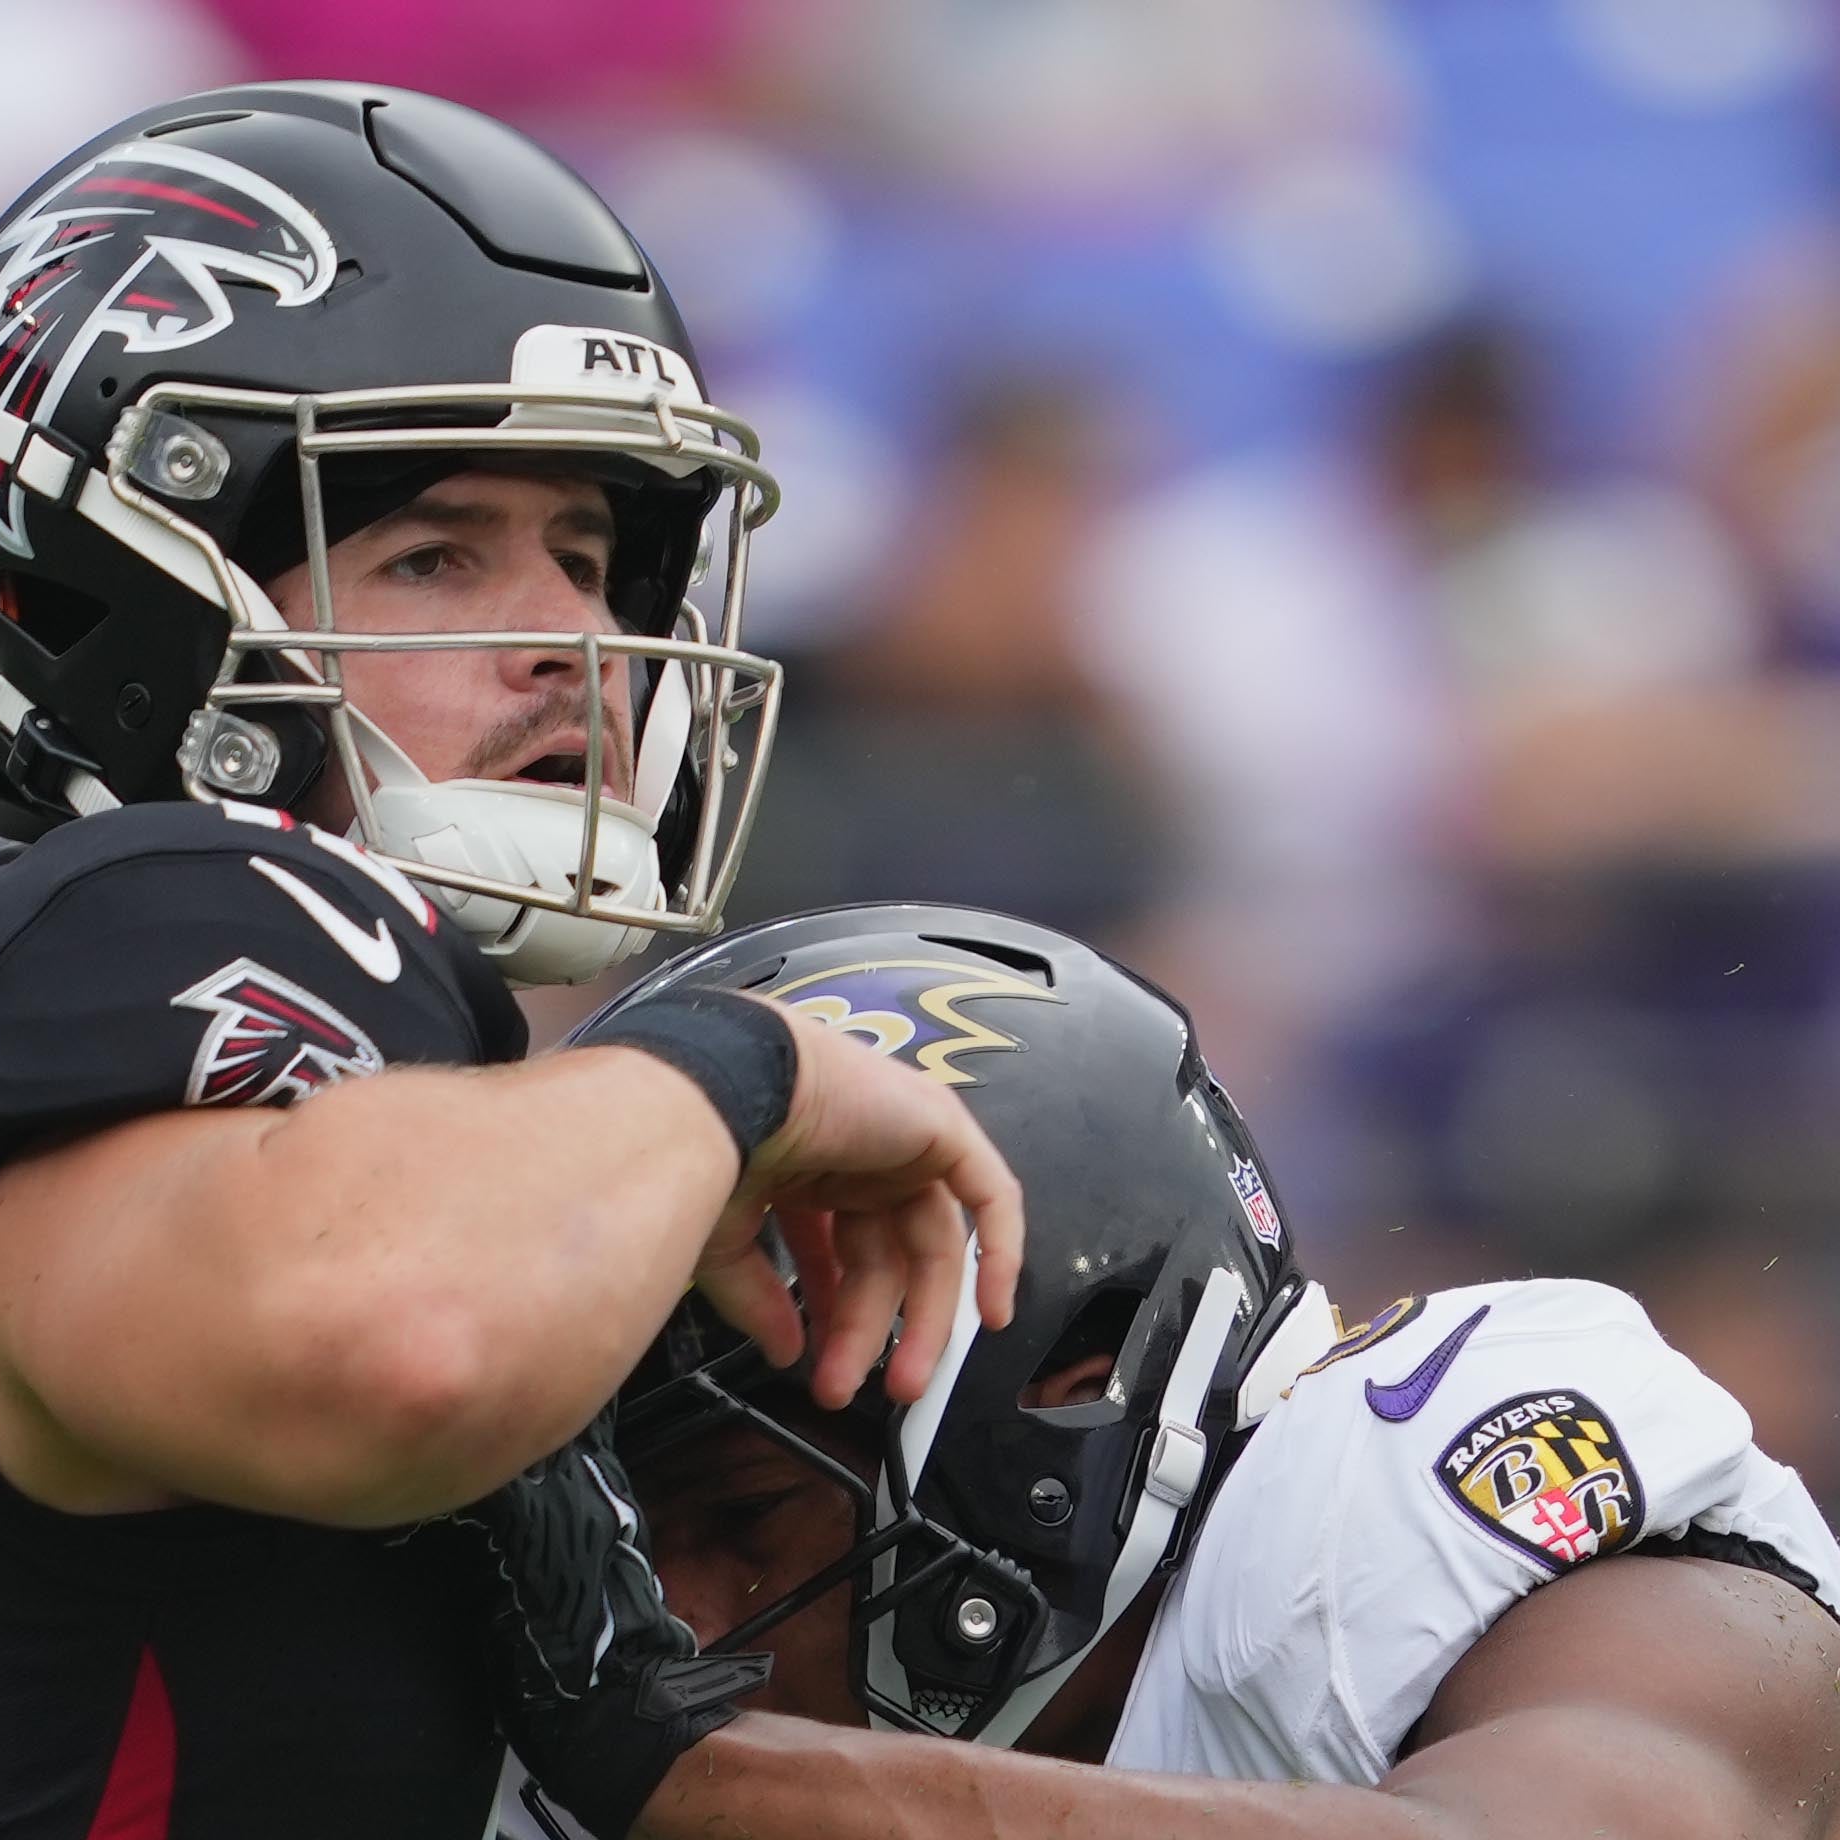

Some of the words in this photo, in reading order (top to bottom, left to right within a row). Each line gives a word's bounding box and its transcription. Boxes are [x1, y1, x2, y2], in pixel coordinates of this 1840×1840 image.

[581, 337, 677, 387] ATL
[1445, 1395, 1576, 1477] RAVENS
[1467, 1439, 1546, 1516] B
[1567, 1467, 1634, 1538] R
